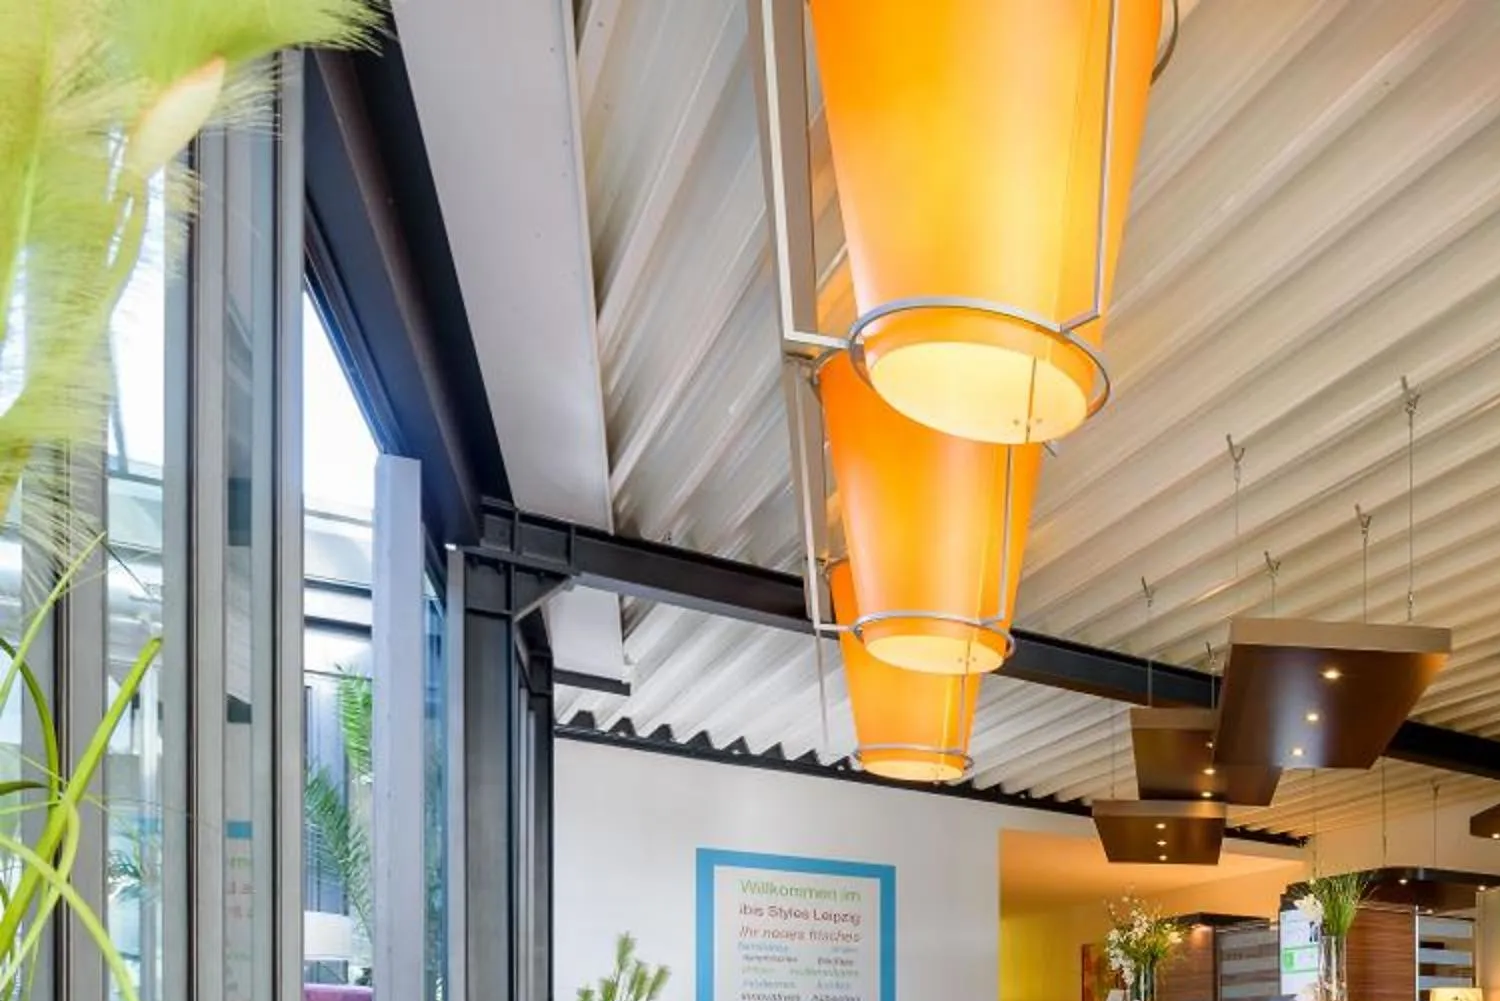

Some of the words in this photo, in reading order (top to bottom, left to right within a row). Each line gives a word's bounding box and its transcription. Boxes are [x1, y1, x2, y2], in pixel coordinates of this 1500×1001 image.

[739, 879, 838, 901] Willkommen
[839, 889, 862, 902] im
[739, 903, 764, 917] ibis
[767, 905, 810, 921] Styles
[812, 909, 862, 926] Leipzig
[739, 925, 758, 938] Ihr
[762, 929, 806, 941] neues
[808, 930, 861, 943] frisches
